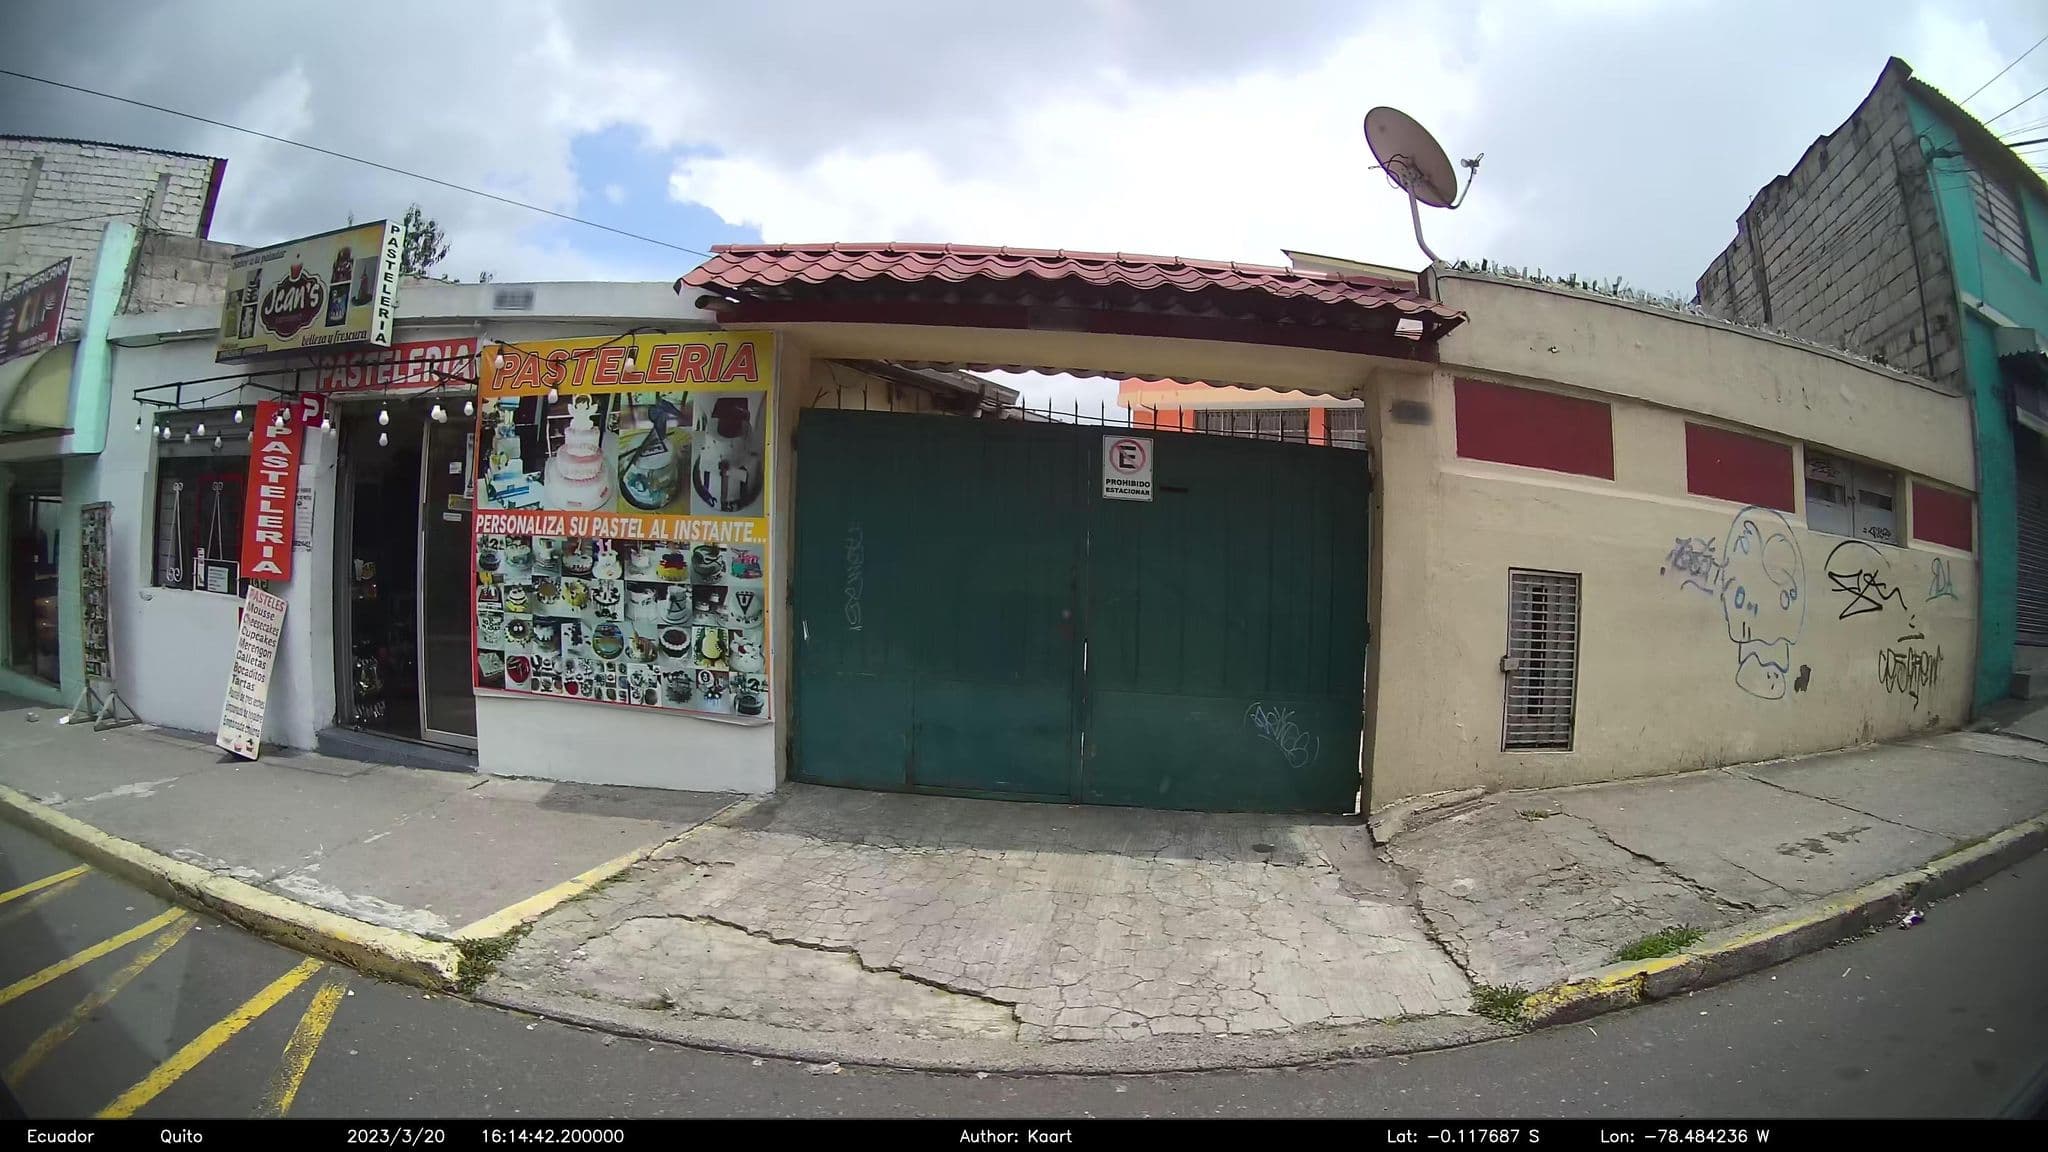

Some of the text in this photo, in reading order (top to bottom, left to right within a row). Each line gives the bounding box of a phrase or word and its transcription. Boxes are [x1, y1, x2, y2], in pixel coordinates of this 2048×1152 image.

[375, 224, 401, 344] PASTELERIA
[264, 281, 320, 316] Jean's
[301, 329, 368, 347] belleza y frescura
[319, 344, 471, 389] PASTELERIA
[492, 342, 759, 390] PASTELERIA
[1105, 478, 1151, 488] PROHIBIDO
[1105, 487, 1150, 496] ESTACIONAR
[251, 425, 293, 575] PASTELERIA
[475, 513, 565, 535] PERSONALIZA
[570, 517, 587, 536] SU
[592, 518, 645, 538] PASTEL
[649, 519, 669, 539] AL
[673, 519, 768, 543] INSTANTE...
[246, 601, 275, 621] Mousse
[249, 588, 285, 612] PASTELES
[241, 626, 277, 648] Cupcakes
[236, 649, 267, 670] Galletas
[232, 673, 255, 691] Tartas
[233, 661, 266, 683] Bocaditos
